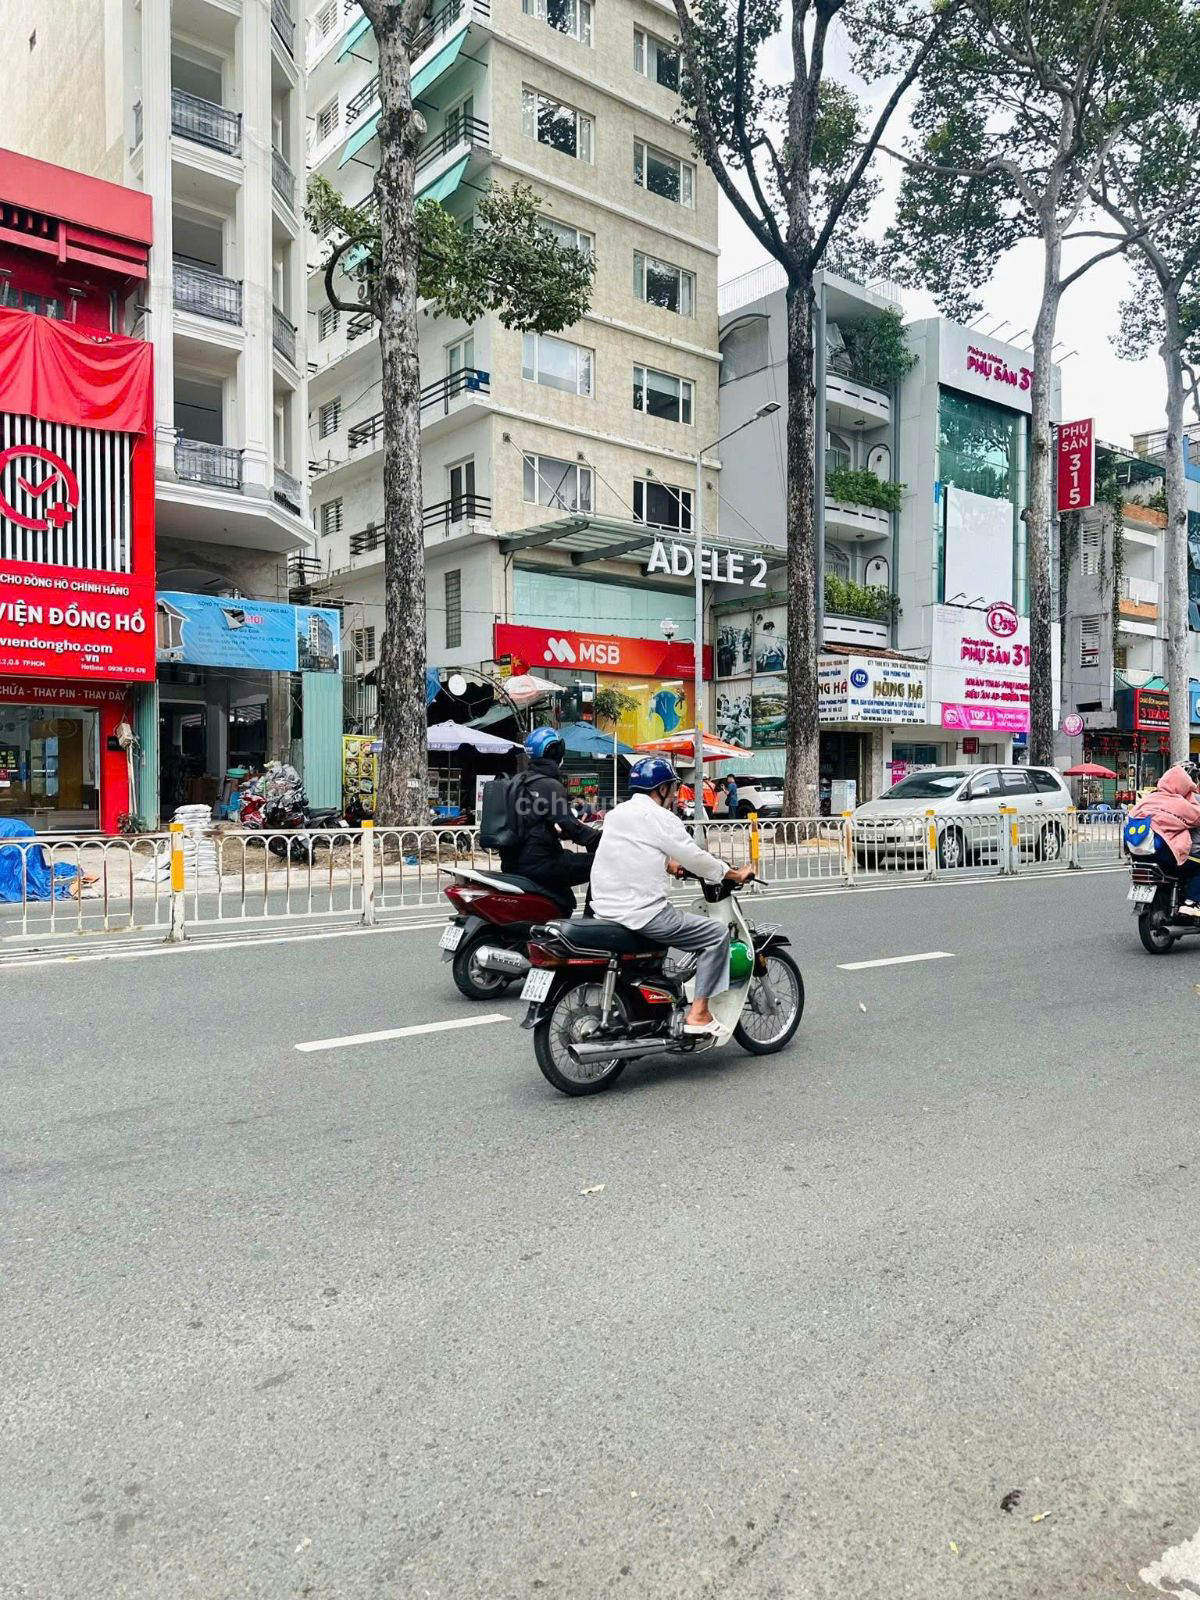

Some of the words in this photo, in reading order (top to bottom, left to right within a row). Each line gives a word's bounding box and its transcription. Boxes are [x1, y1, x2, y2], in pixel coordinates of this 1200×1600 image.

[967, 355, 992, 381] PHỤ
[994, 363, 1018, 387] SẢN
[1062, 423, 1089, 439] PHỤ
[1061, 436, 1089, 452] SẢN
[646, 541, 744, 585] ADELE
[749, 557, 768, 588] 2
[0, 573, 22, 585] CHO
[70, 581, 101, 593] CHÍNH
[103, 583, 129, 596] HÃNG
[49, 602, 111, 630] ĐỒNG
[0, 637, 113, 654] viendongho.com
[579, 642, 620, 665] MSB
[960, 646, 986, 665] PHỤ
[987, 645, 1011, 665] SẢN
[1012, 644, 1031, 667] 31
[33, 688, 57, 697] THAY
[60, 689, 76, 698] PIN
[84, 690, 107, 699] THAY
[817, 683, 831, 695] NG
[970, 711, 986, 721] TOP
